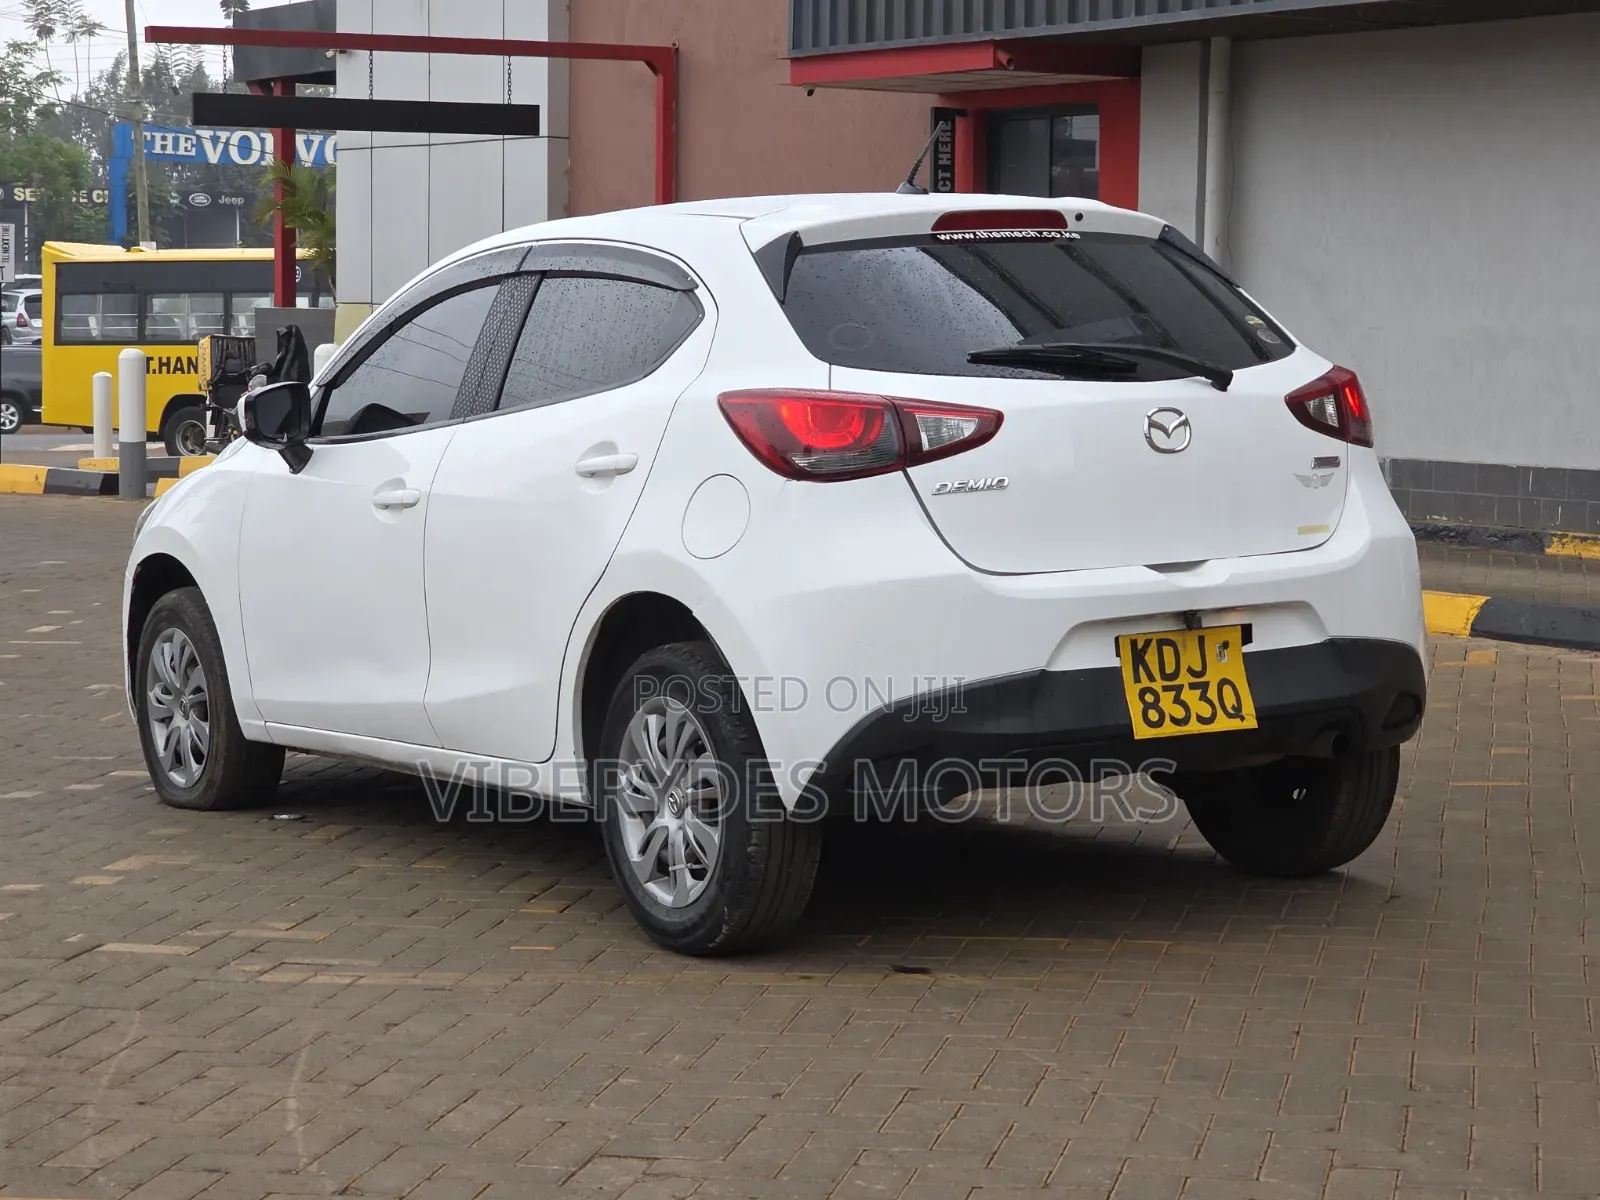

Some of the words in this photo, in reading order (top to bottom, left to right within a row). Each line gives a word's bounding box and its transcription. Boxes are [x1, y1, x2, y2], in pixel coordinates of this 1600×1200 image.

[219, 195, 244, 206] Jeep
[937, 230, 1081, 240] www.themech.co.ke
[2, 238, 10, 253] NEXT
[932, 476, 1009, 496] DEMIO
[1129, 635, 1208, 685] KDJ
[1137, 677, 1246, 729] 833Q
